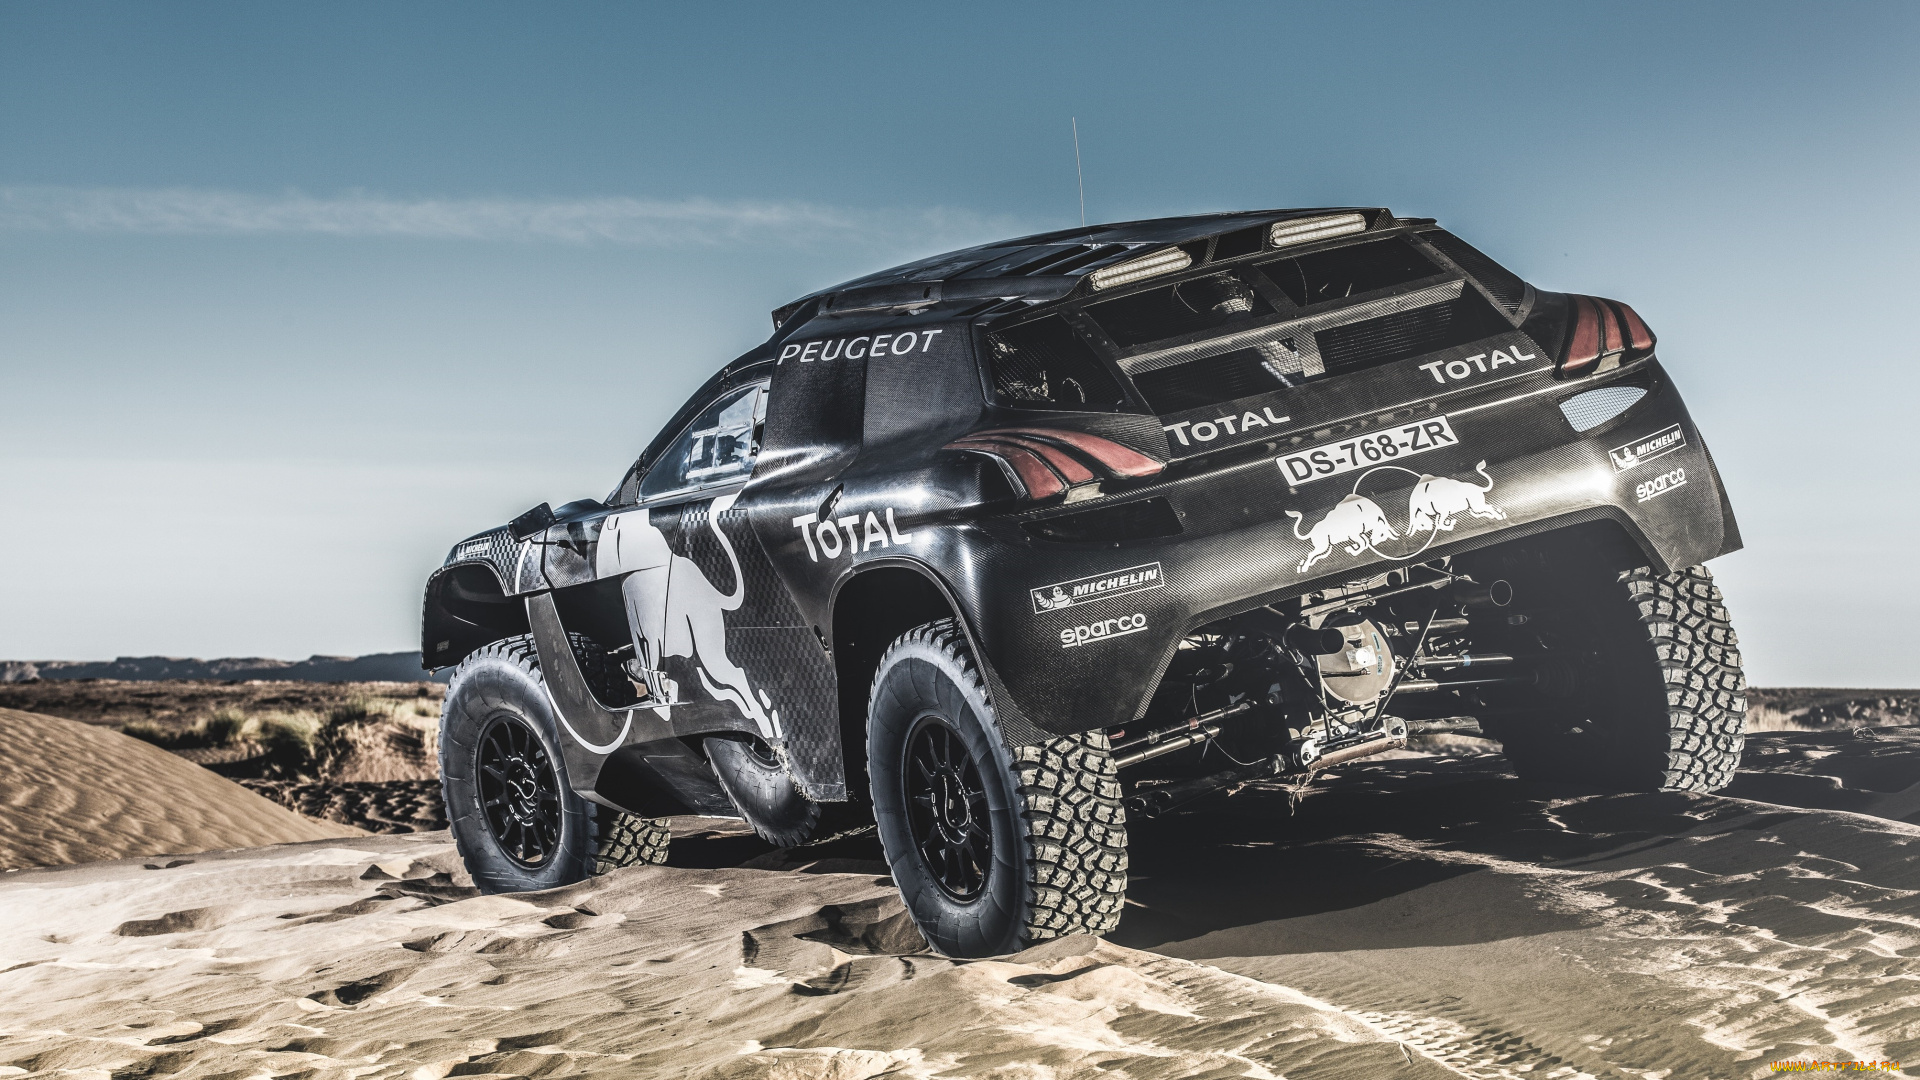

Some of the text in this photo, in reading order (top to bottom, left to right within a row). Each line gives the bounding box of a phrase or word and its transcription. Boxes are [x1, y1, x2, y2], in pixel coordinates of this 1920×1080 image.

[777, 329, 943, 366] PEUGEOT
[1418, 345, 1536, 384] TOTAL
[1162, 407, 1291, 446] TOTAL
[1636, 429, 1681, 457] MICHELIN
[1285, 421, 1454, 482] DS-768-ZR
[1636, 467, 1686, 501] sparco
[792, 507, 912, 563] TOTAL
[1073, 568, 1158, 597] MICHELIN
[1060, 613, 1147, 647] sparco
